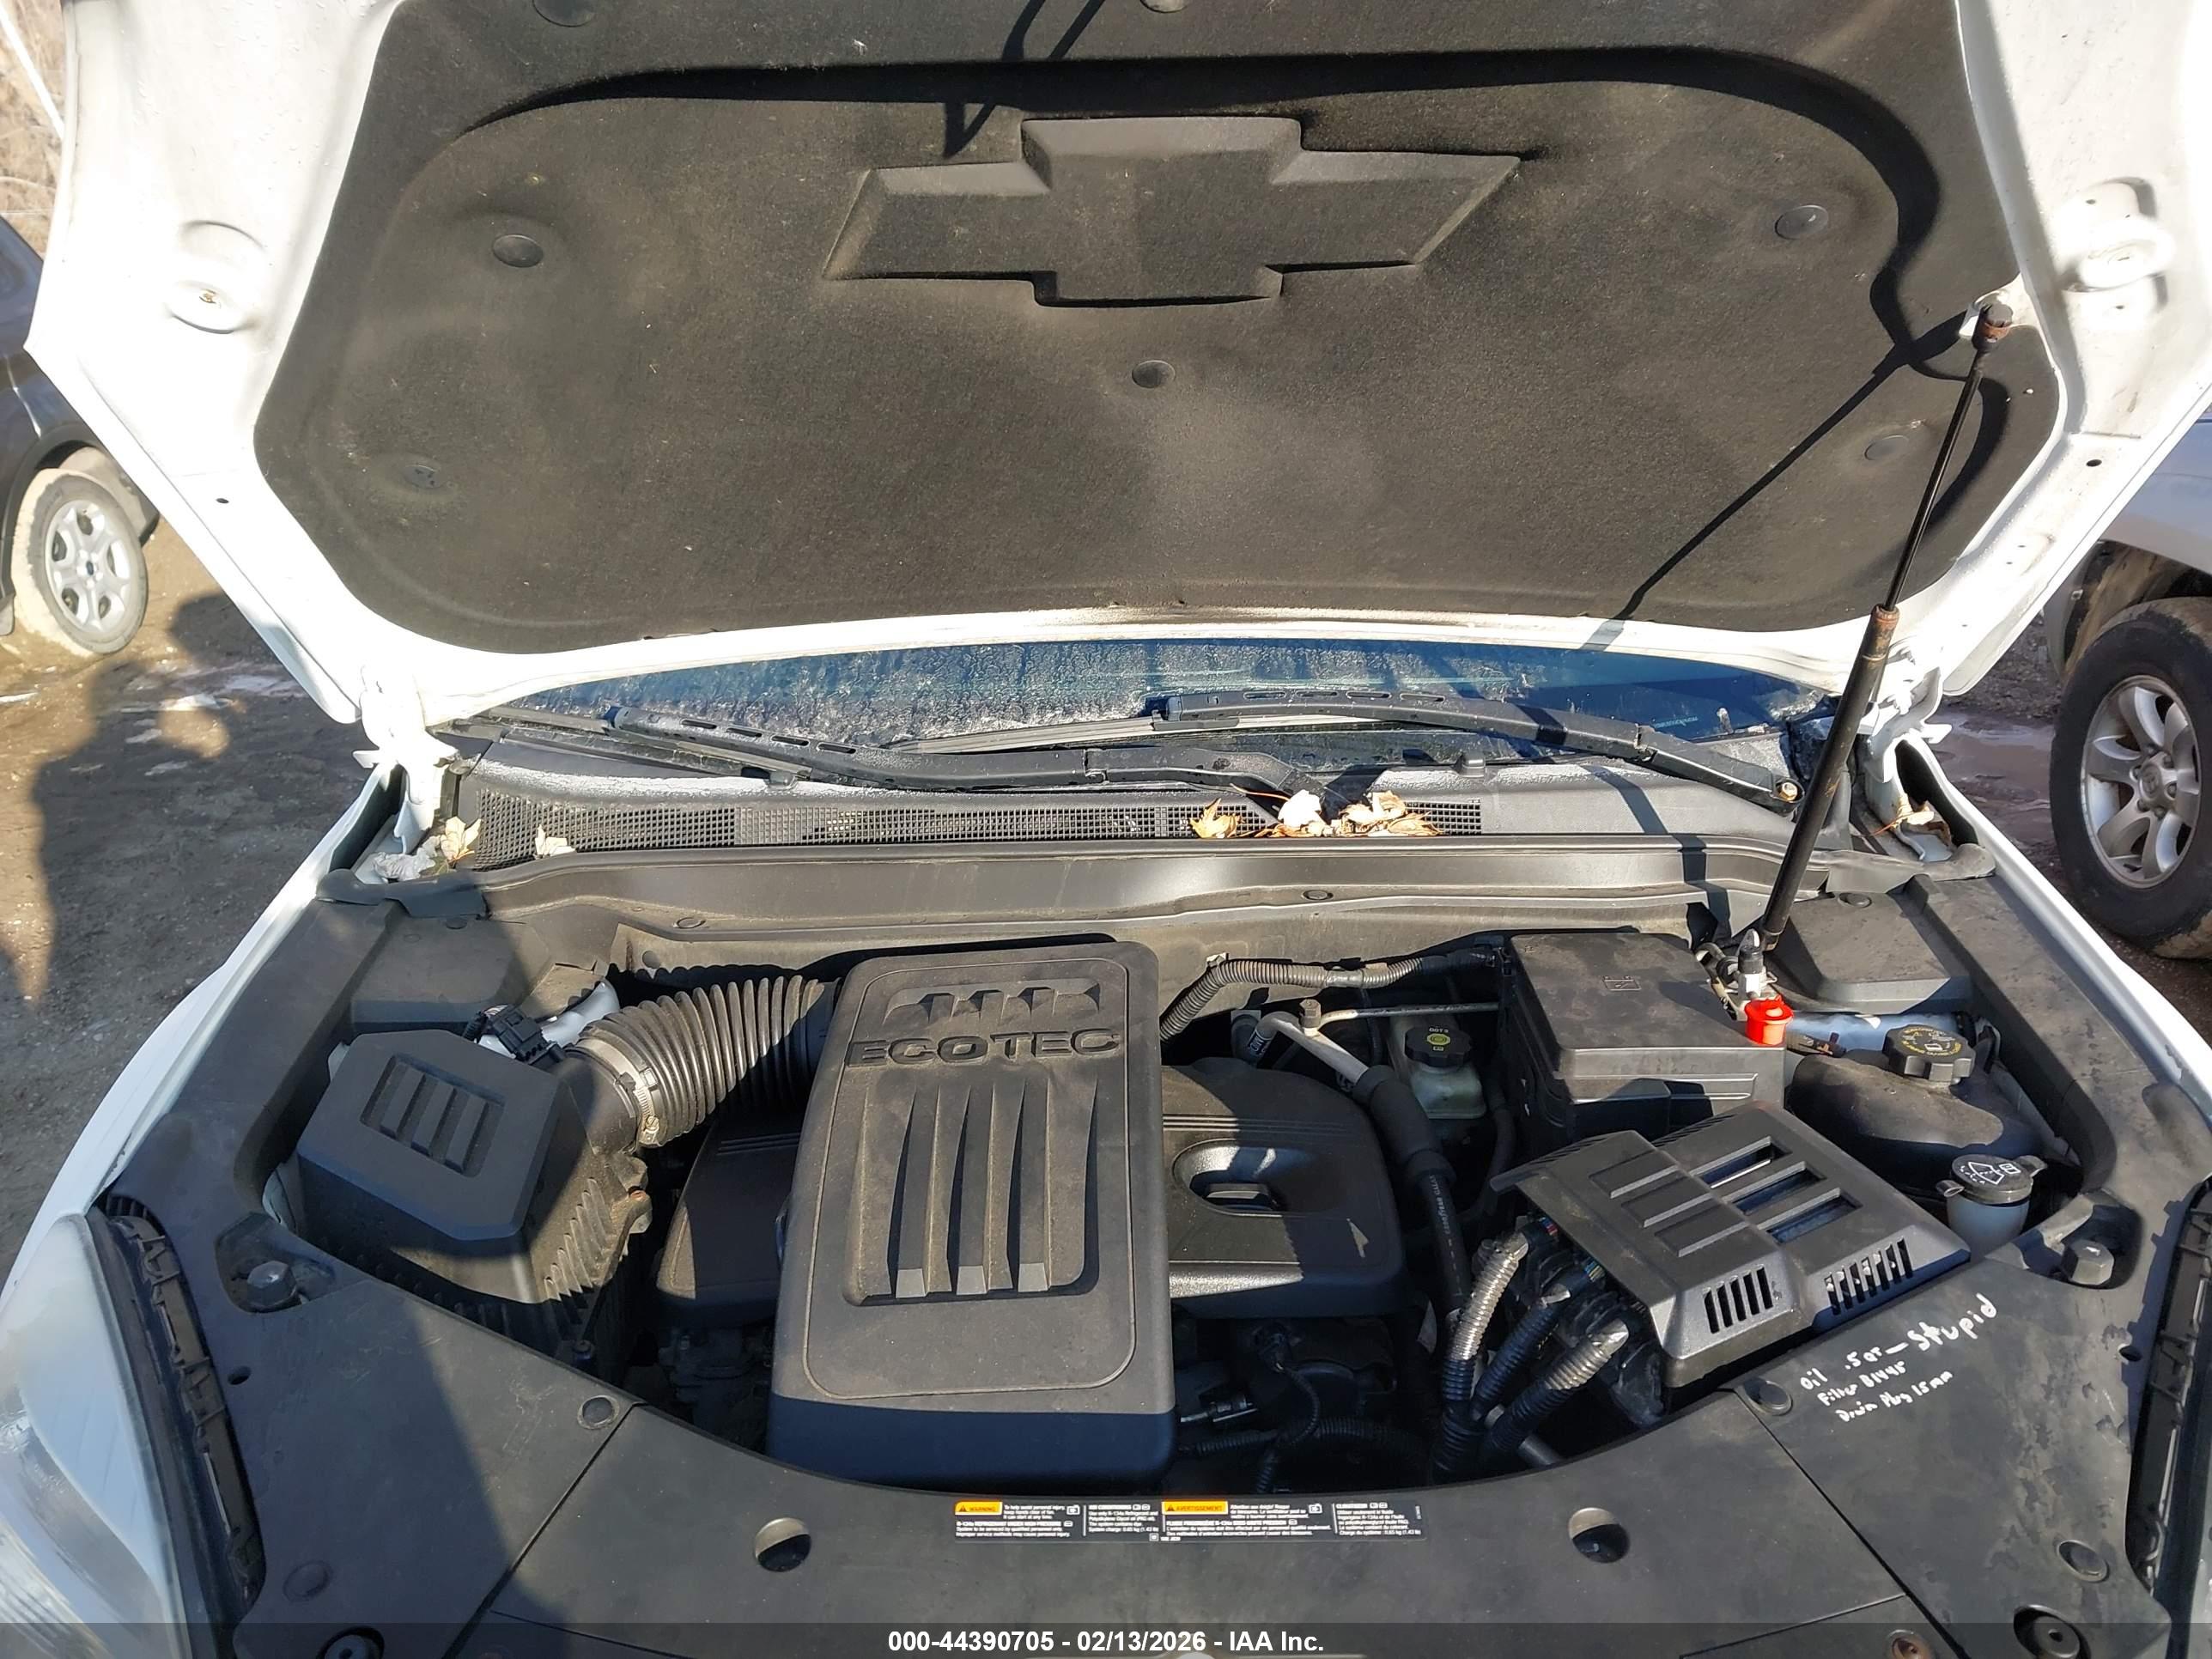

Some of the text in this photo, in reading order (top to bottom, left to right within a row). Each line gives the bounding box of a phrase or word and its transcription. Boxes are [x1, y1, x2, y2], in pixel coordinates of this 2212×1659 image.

[847, 1028, 1121, 1066] ECOTEC
[1800, 1367, 1828, 1390] Oil
[1817, 1384, 1858, 1406] Filter
